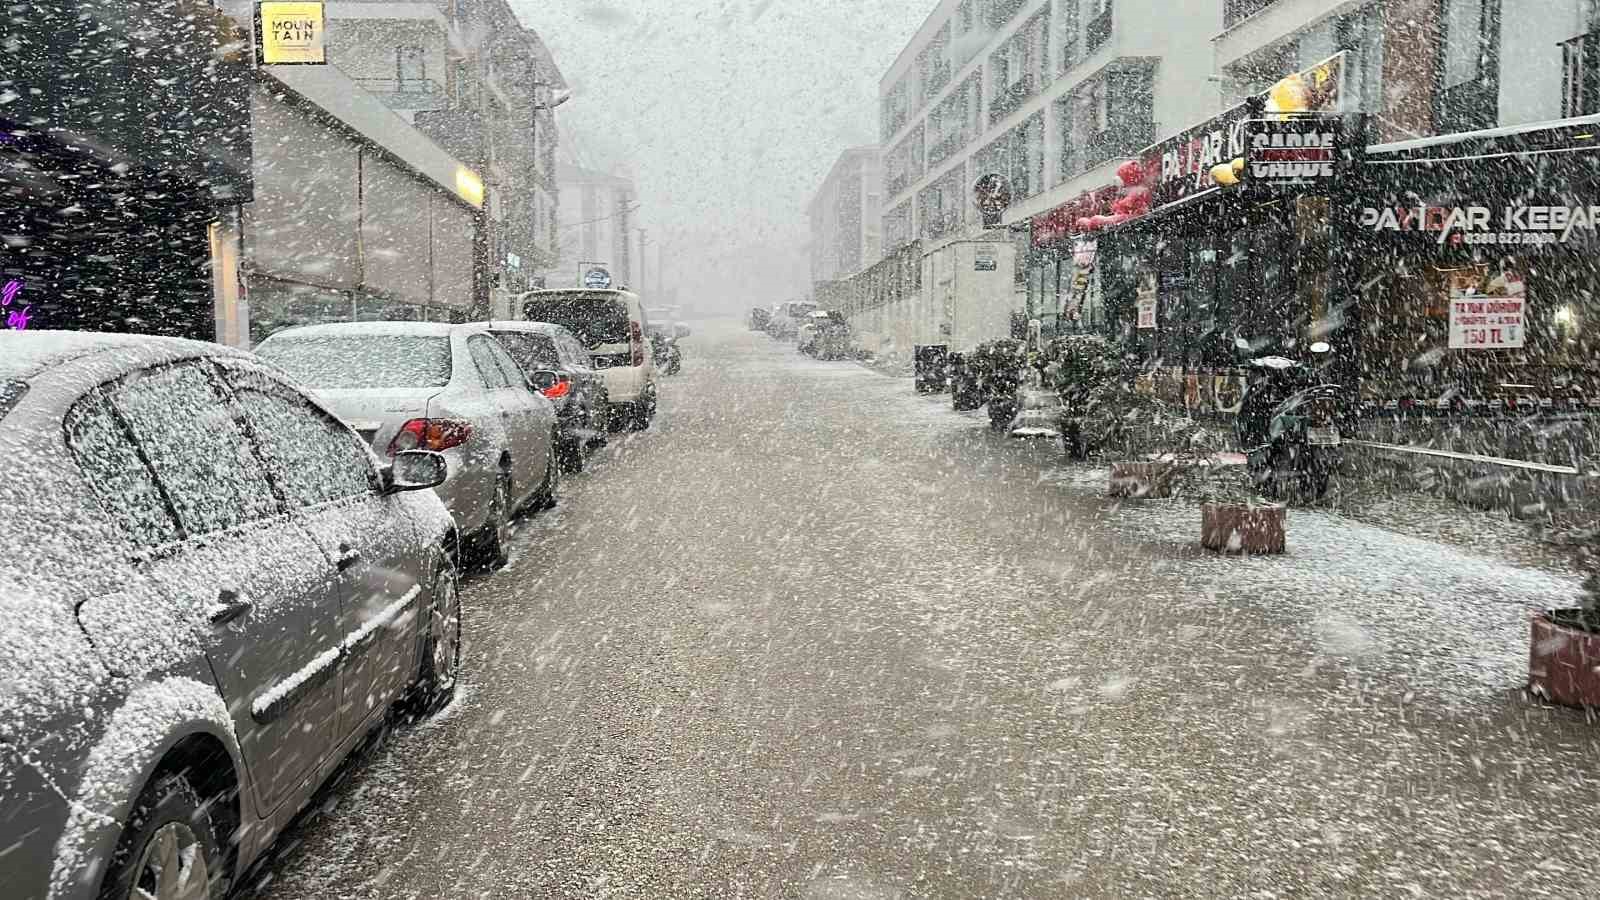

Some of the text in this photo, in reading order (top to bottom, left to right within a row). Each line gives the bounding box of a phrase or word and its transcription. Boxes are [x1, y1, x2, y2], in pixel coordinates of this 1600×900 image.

[272, 20, 313, 30] MOUN
[272, 31, 313, 41] TAIN
[1490, 328, 1504, 344] TL
